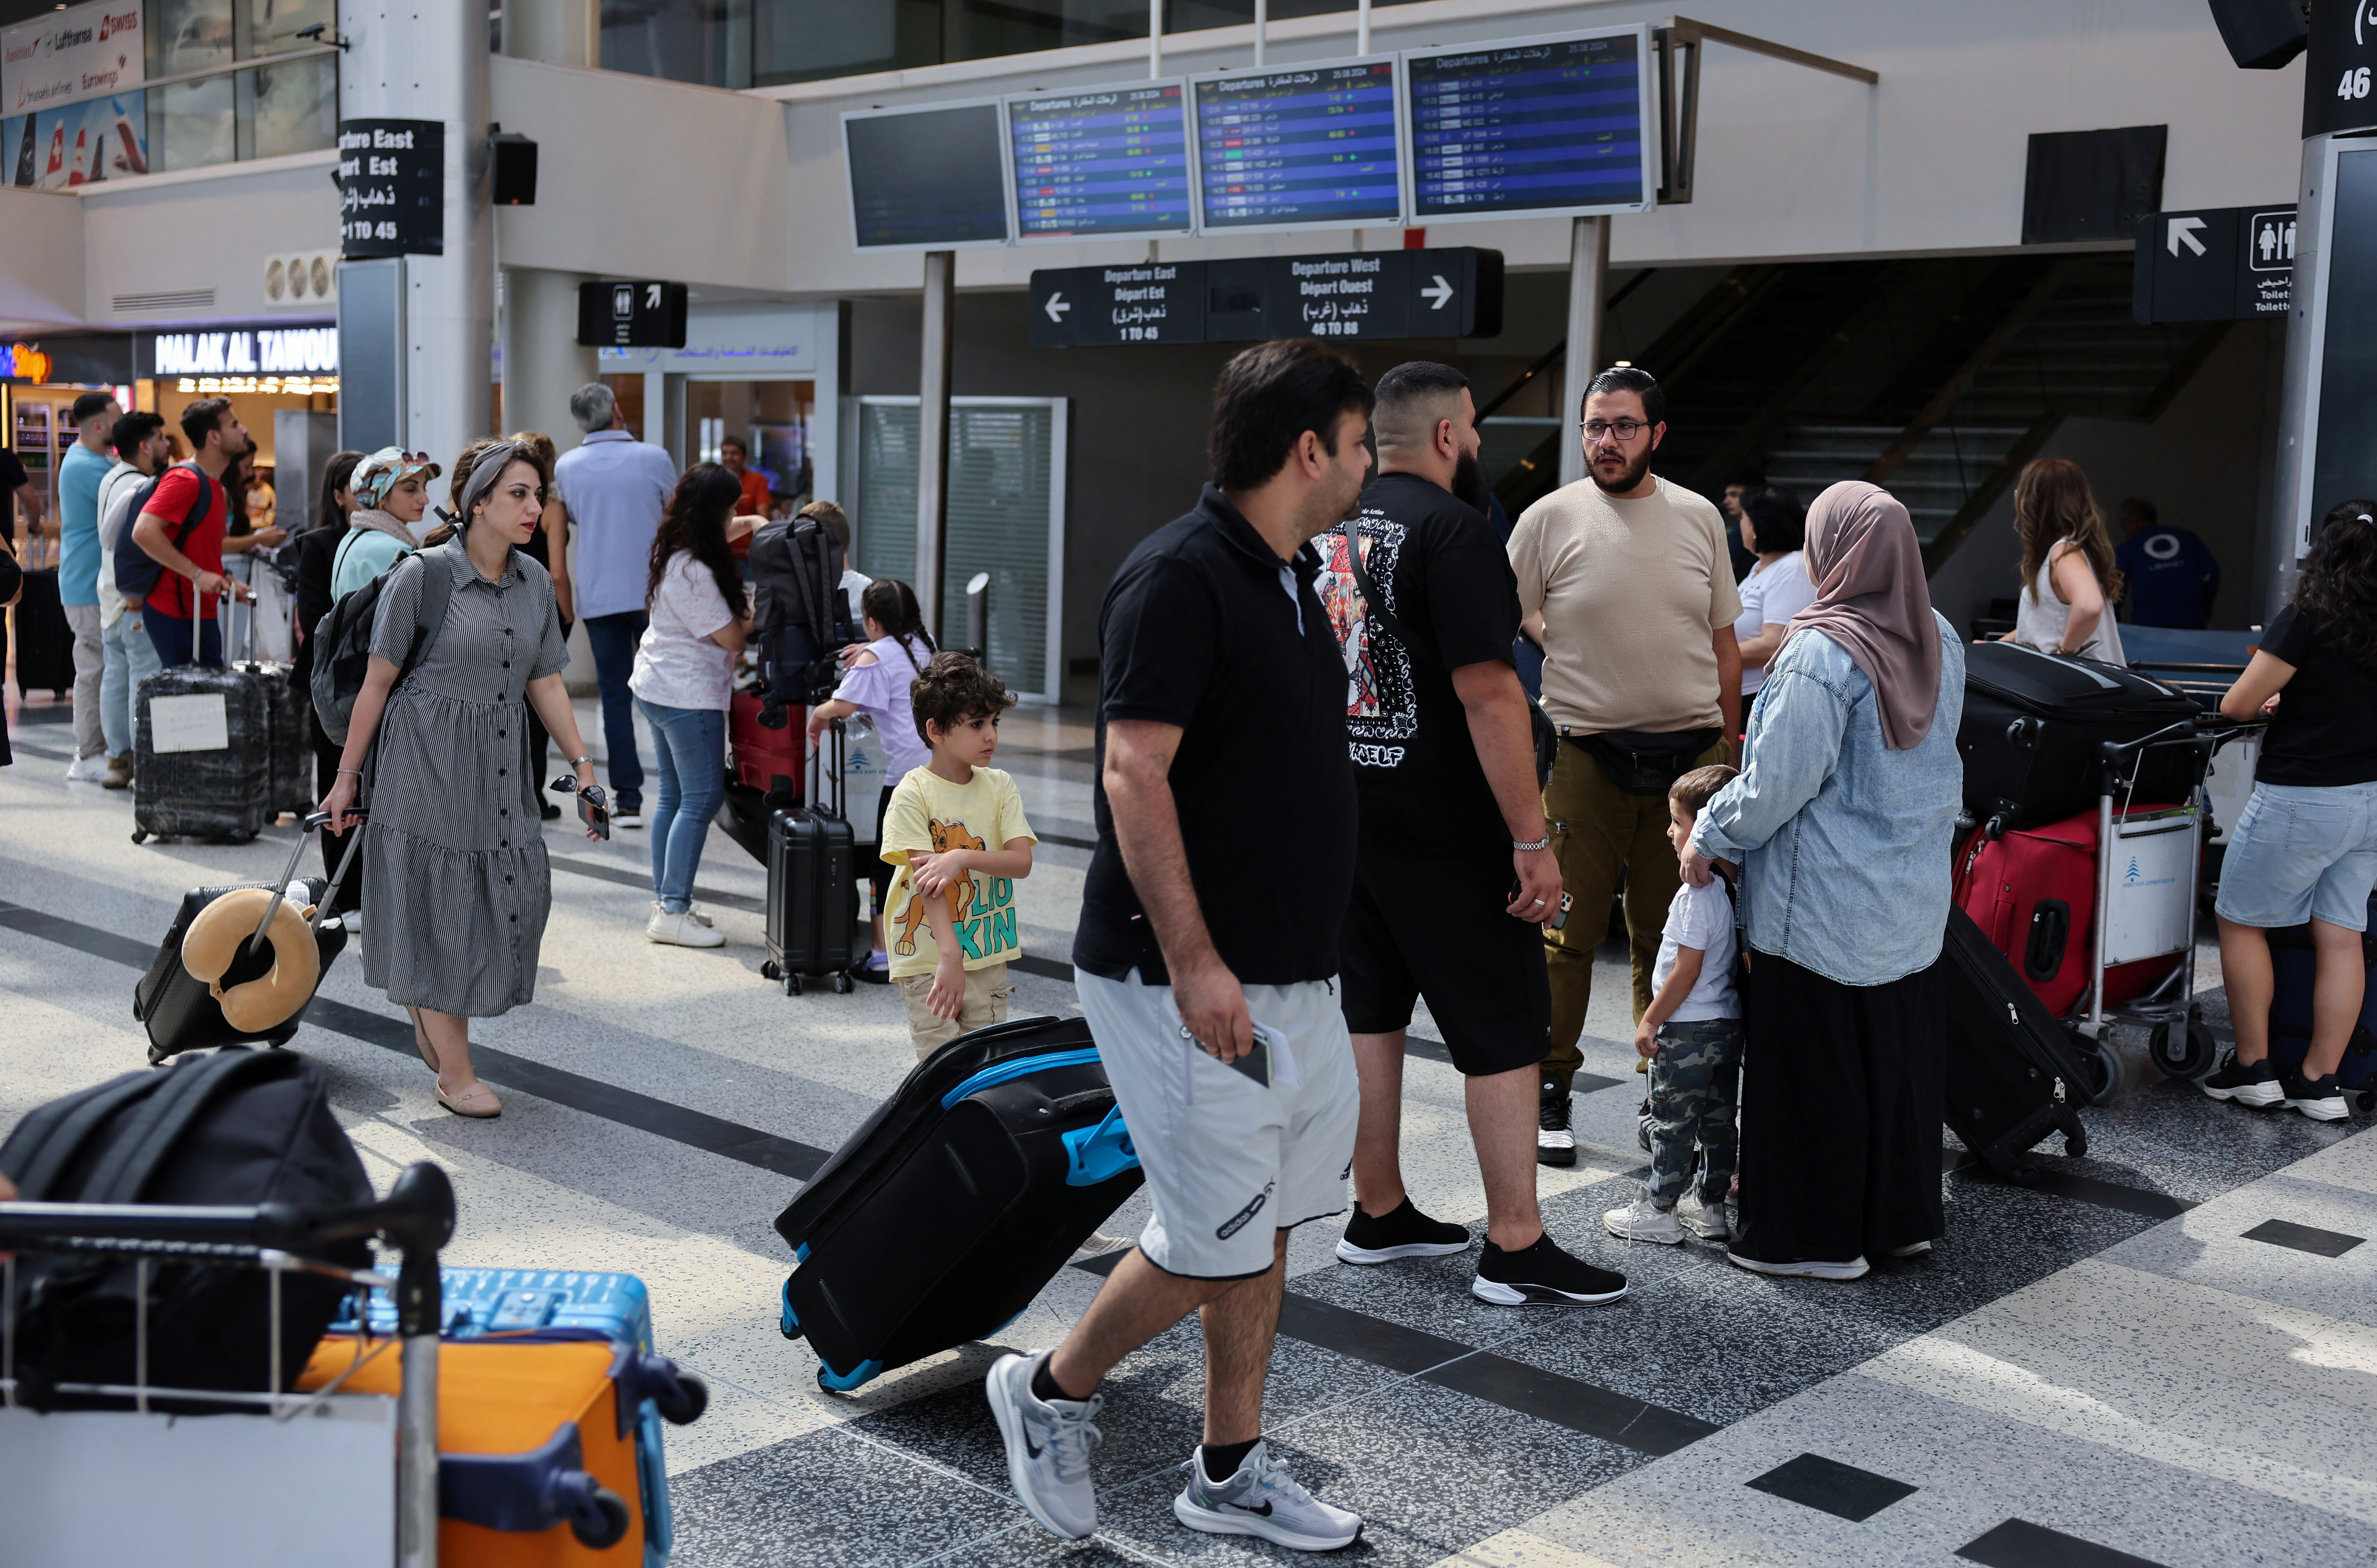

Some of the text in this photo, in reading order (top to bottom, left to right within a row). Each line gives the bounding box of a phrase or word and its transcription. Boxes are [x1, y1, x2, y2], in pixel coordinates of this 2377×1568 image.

[54, 27, 93, 51] Lufthansa
[5, 45, 32, 64] Austrian
[1436, 55, 1489, 70] Departures
[82, 68, 119, 90] Eurowings
[1219, 79, 1265, 93] Departures
[2338, 66, 2371, 101] 46
[1030, 99, 1071, 112] Departures
[374, 129, 414, 149] East
[369, 156, 398, 176] Est
[359, 184, 396, 209] ذهاب
[354, 221, 372, 240] TO
[374, 221, 397, 240] 45
[1104, 266, 1176, 285] Departure East
[1292, 258, 1380, 278] Departure West
[1114, 286, 1165, 304] Départ Est
[1300, 278, 1373, 298] Départ Ouest
[1112, 304, 1167, 325] ذهاب (شرق)
[1303, 299, 1368, 322] ذهاب (غرب)
[1120, 326, 1159, 340] 1 TO 45
[1311, 321, 1359, 336] 46 TO 88
[156, 328, 339, 374] MALAK AL TAWOU
[971, 876, 1014, 917] LIO
[952, 907, 1018, 960] KIN
[1220, 1212, 1251, 1237] adidas
